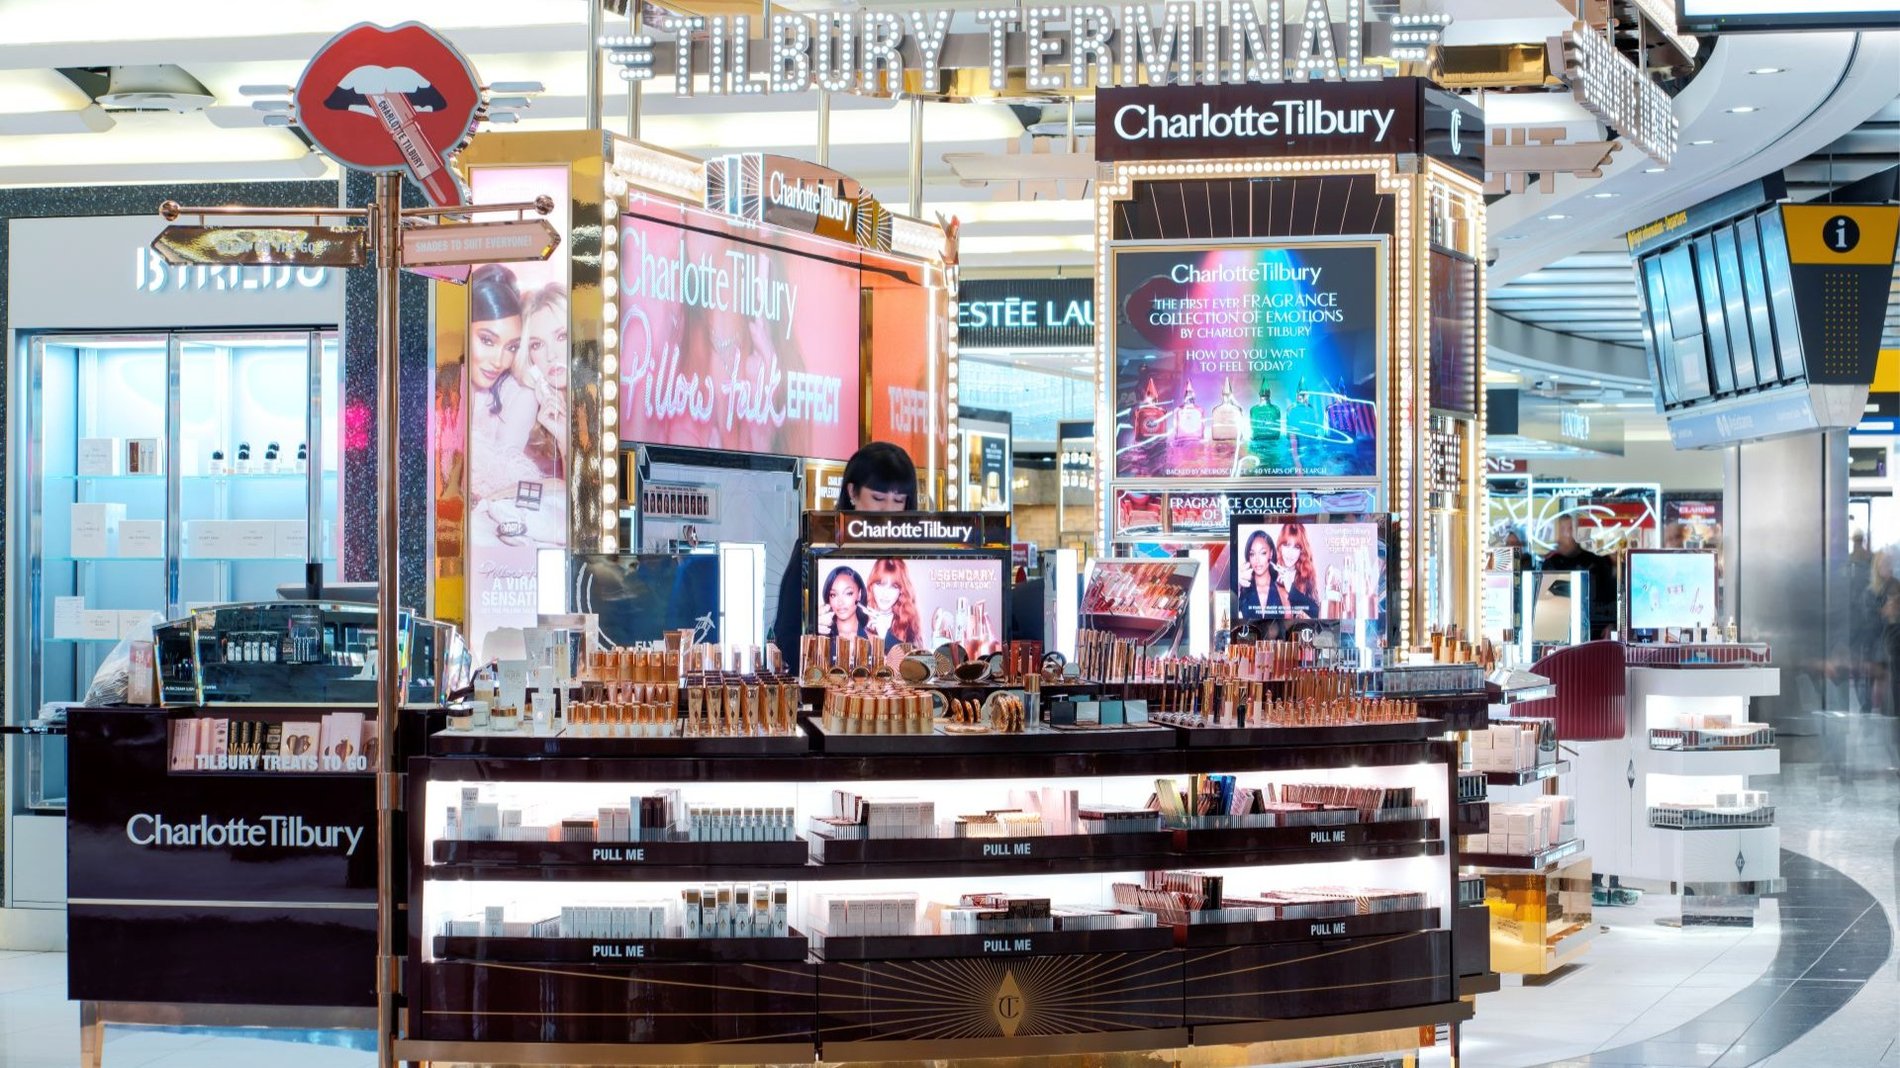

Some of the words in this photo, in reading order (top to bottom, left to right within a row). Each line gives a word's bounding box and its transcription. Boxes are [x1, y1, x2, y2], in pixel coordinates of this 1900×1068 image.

[662, 8, 954, 98] TILBURY
[975, 0, 1384, 89] TERMINAL
[1114, 100, 1395, 142] CharlotteTilbury
[378, 101, 407, 140] CHARLOTTE
[403, 139, 425, 168] TILBURY
[770, 170, 852, 230] CharlotteTilbury
[416, 239, 448, 252] SHADES
[451, 239, 462, 250] TO
[464, 238, 482, 250] SUIT
[486, 235, 532, 249] EVERYONE!
[1171, 262, 1322, 285] CharlotteTilbury
[620, 227, 798, 339] CharlotteTilbury
[1156, 298, 1177, 310] THE
[1180, 298, 1211, 310] FIRST
[1213, 298, 1240, 310] EVER
[1243, 292, 1338, 309] FRAGRANCE
[1150, 311, 1241, 326] COLLECTION
[1243, 311, 1261, 324] OF
[1266, 309, 1343, 323] EMOTIONS
[1180, 328, 1193, 339] BY
[1197, 327, 1263, 338] CHARLOTTE
[1267, 325, 1311, 337] TILBURY
[1186, 350, 1216, 361] HOW
[1220, 350, 1239, 360] DO
[1243, 349, 1267, 360] YOU
[1270, 348, 1305, 359] WANT
[620, 304, 714, 422] Pillow
[722, 350, 786, 431] talk
[787, 371, 842, 423] EFFECT
[1200, 362, 1215, 372] TO
[1219, 361, 1243, 372] FEEL
[1249, 360, 1292, 371] TODAY?
[1170, 497, 1241, 509] FRAGRANCE
[1244, 496, 1322, 508] COLLECTION
[1203, 510, 1219, 521] OF
[848, 520, 972, 541] CharlotteTilbury
[196, 755, 258, 770] TILBURY
[262, 755, 318, 771] TREATS
[323, 755, 341, 771] TO
[346, 755, 367, 771] GO
[126, 813, 364, 856] CharlotteTilbury
[1310, 831, 1330, 843] PULL
[1333, 830, 1346, 842] ME
[592, 849, 623, 862] PULL
[625, 848, 645, 861] ME
[983, 844, 1010, 856] PULL
[1014, 843, 1031, 855] ME
[1311, 924, 1331, 936] PULL
[1333, 922, 1346, 934] ME
[592, 945, 623, 958] PULL
[625, 945, 645, 957] ME
[984, 940, 1011, 952] PULL
[1014, 939, 1031, 951] ME
